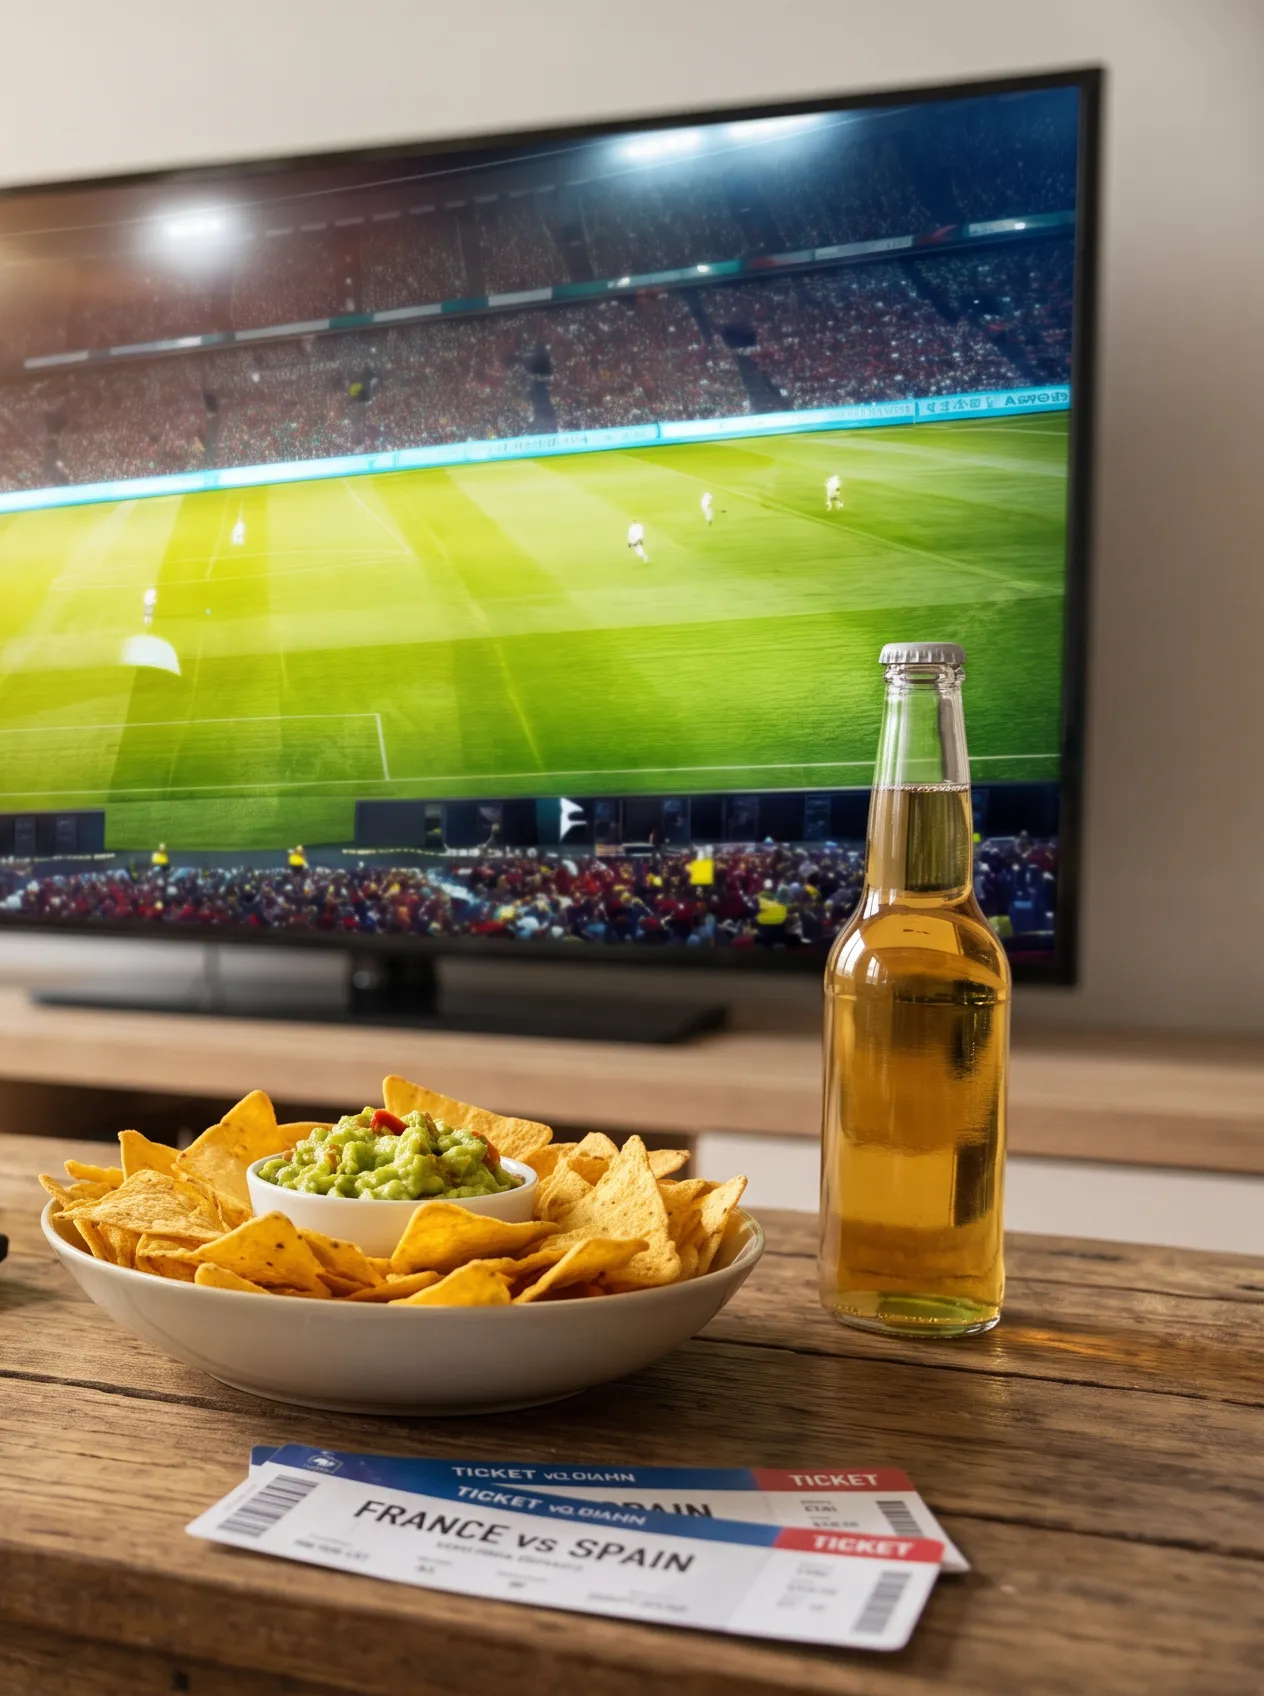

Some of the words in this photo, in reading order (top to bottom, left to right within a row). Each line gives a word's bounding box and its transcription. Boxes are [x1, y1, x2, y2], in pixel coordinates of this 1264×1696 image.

[452, 1466, 536, 1480] TICKET
[788, 1473, 878, 1487] TICKET
[457, 1485, 543, 1510] TICKET
[353, 1499, 511, 1546] FRANCE
[568, 1537, 696, 1574] SPAIN
[812, 1534, 914, 1558] TICKET
